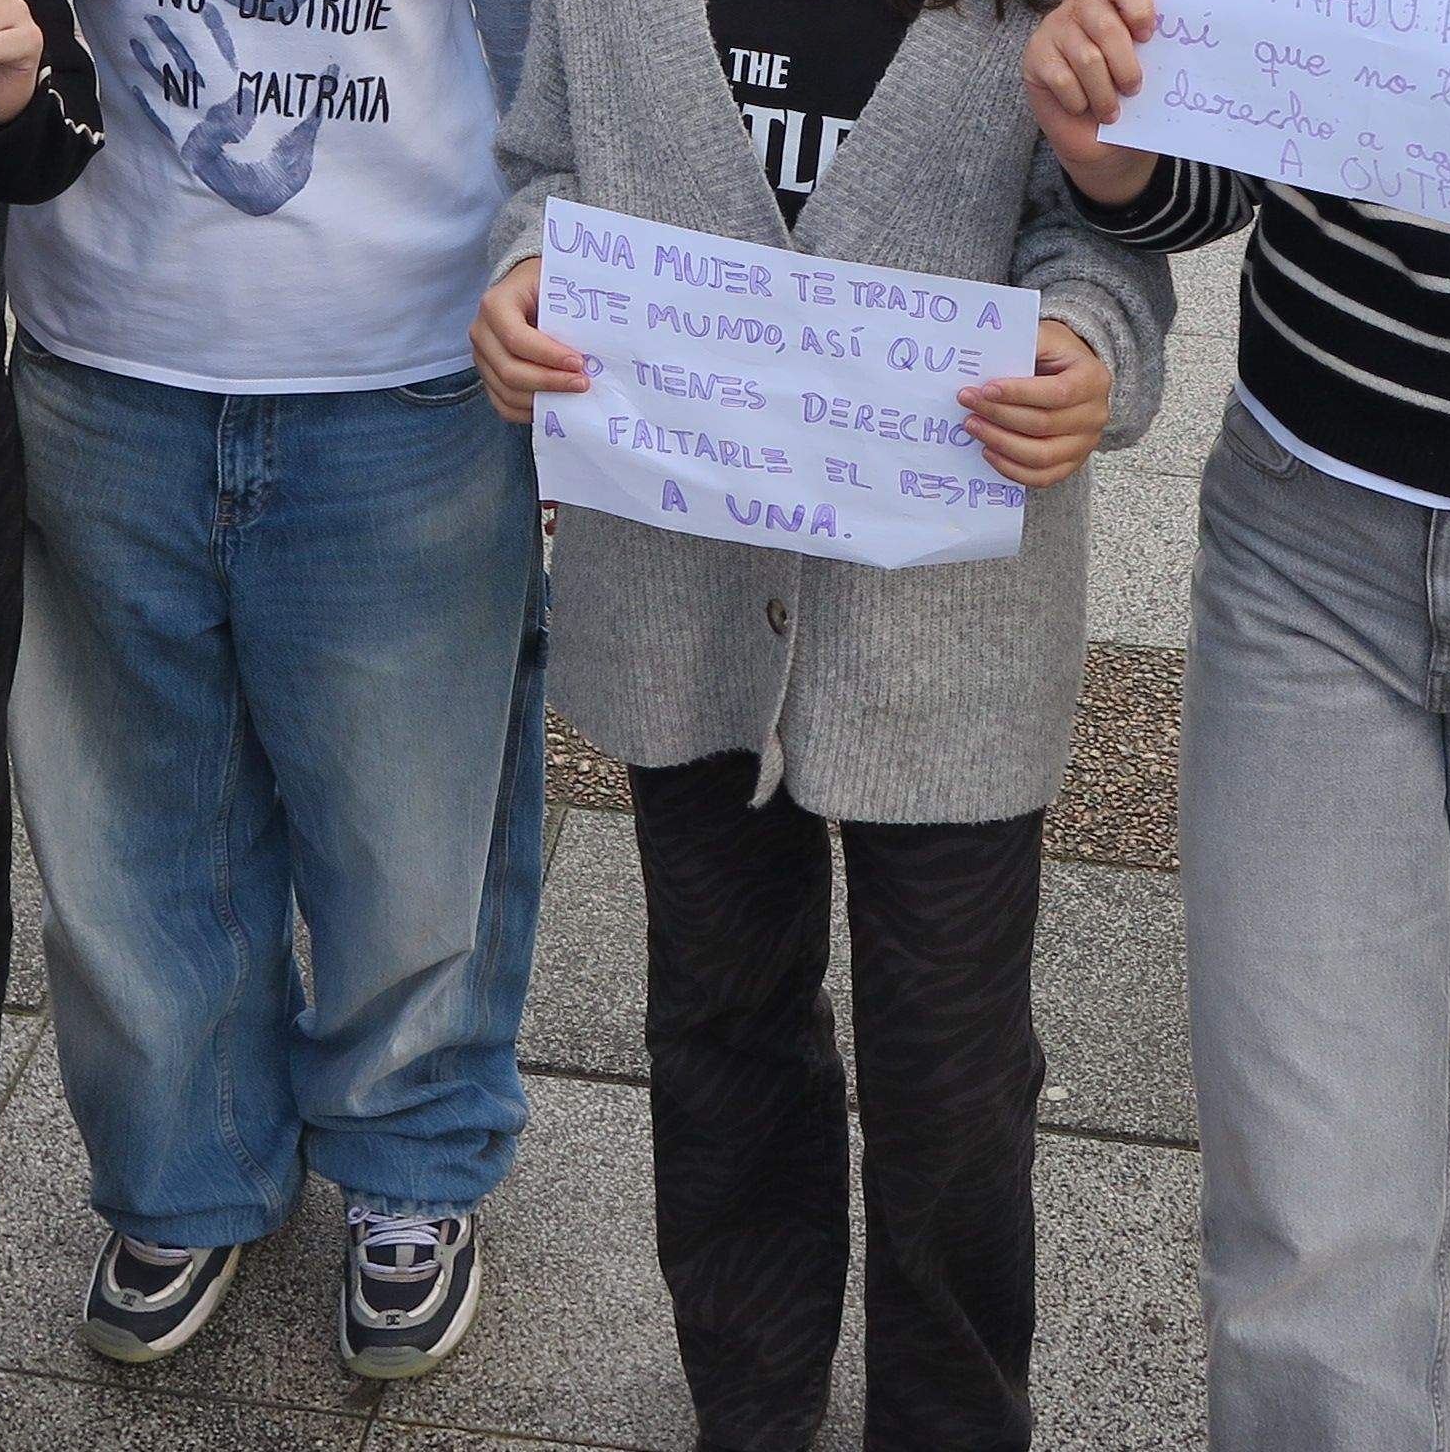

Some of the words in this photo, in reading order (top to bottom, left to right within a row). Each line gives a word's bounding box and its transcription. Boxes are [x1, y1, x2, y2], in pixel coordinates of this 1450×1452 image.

[161, 63, 199, 109] NI
[237, 70, 389, 123] MALTRATA
[729, 47, 791, 89] THE
[1254, 40, 1331, 88] que
[1354, 65, 1416, 94] no
[1164, 69, 1335, 140] derecho
[1358, 131, 1384, 151] a
[1280, 140, 1303, 178] A
[549, 218, 635, 270] UNA
[654, 245, 772, 299] MUJER
[791, 271, 836, 306] TE
[849, 279, 958, 324] TRAJO
[976, 300, 1002, 331] A
[548, 276, 631, 325] ESTE
[648, 303, 786, 355] MUNDO,
[887, 337, 983, 376] QUE
[632, 359, 766, 410] TIENES
[802, 392, 978, 448] DERECHO
[544, 411, 566, 439] A
[608, 416, 793, 475] FALTARLE
[825, 456, 873, 490] EL
[900, 469, 1025, 509] RESPETO
[661, 480, 689, 514] A
[726, 494, 853, 541] UNA.
